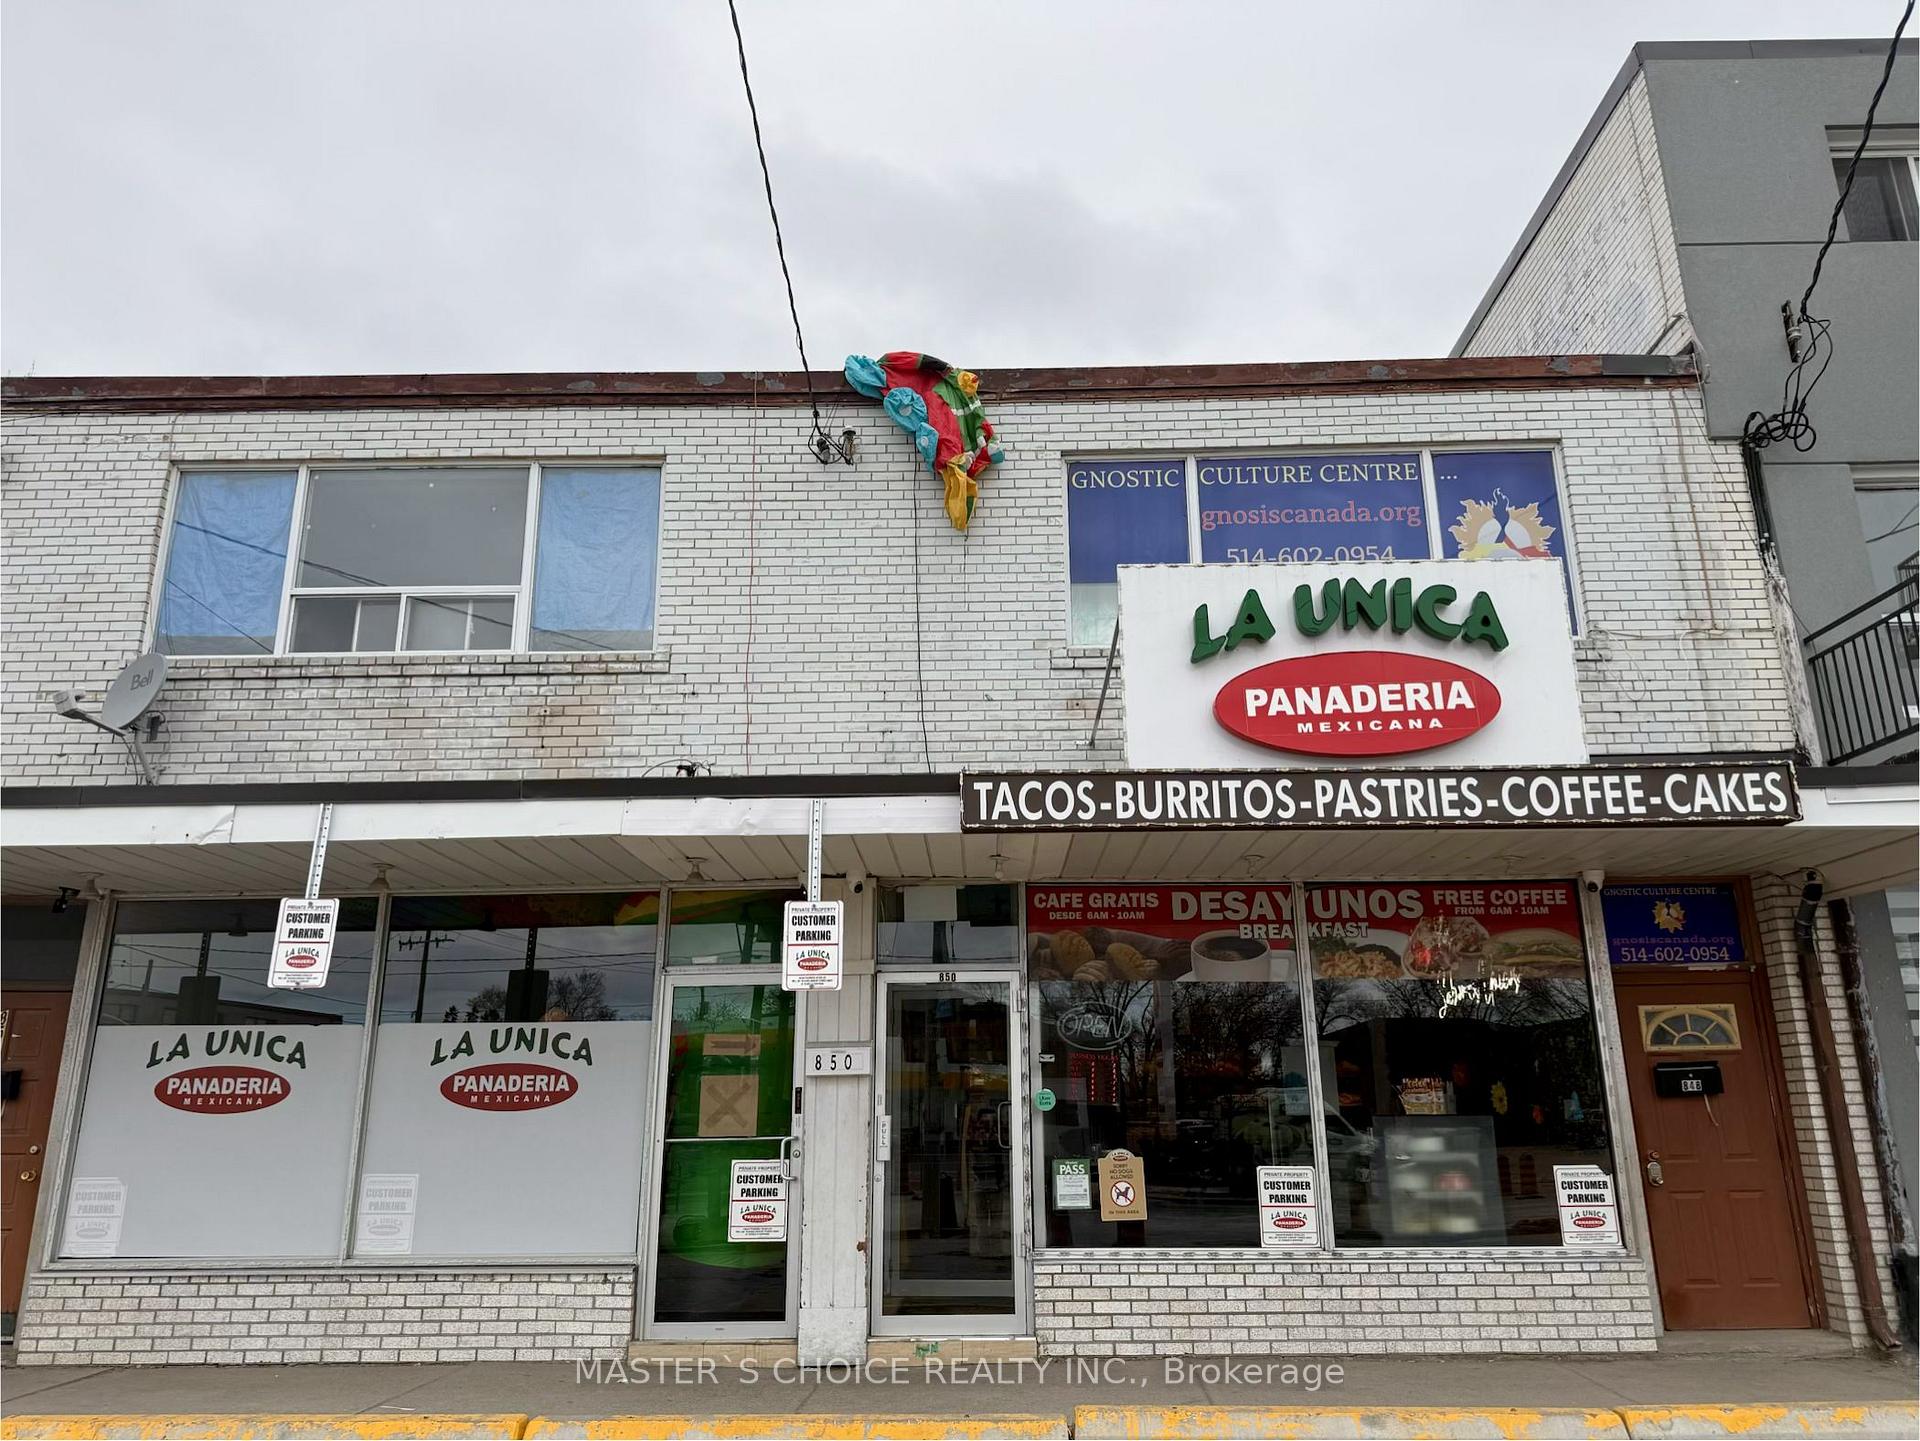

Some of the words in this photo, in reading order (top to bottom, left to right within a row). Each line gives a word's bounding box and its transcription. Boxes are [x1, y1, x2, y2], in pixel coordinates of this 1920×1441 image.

[1071, 468, 1180, 490] GNOSTIC
[1200, 464, 1314, 486] CULTURE
[1319, 462, 1418, 484] CENTRE
[1201, 500, 1421, 531] gnosiscanada.org
[1227, 546, 1396, 564] 514-602-0954
[1190, 588, 1276, 664] LA
[1292, 577, 1509, 652] UNICA
[130, 669, 154, 691] Bell
[1244, 680, 1476, 717] PANADERIA
[1297, 717, 1443, 734] MEXICANA
[1603, 887, 1641, 896] GNOSTIC
[1642, 887, 1681, 896] CULTURE
[1683, 886, 1718, 895] CENTRE
[1033, 892, 1084, 909] CAFE
[1088, 892, 1160, 909] GRATIS
[1432, 889, 1486, 905] FREE
[1489, 889, 1568, 905] COFFEE
[1171, 889, 1425, 921] DESAYUNOS
[1049, 911, 1082, 920] DESDE
[1087, 911, 1109, 920] 6AM
[1117, 911, 1145, 920] 10AM
[1454, 906, 1485, 915] FROM
[1490, 906, 1513, 915] 6AM
[1521, 906, 1549, 915] 10AM
[286, 913, 330, 923] CUSTOMER
[792, 915, 835, 926] CUSTOMER
[288, 928, 324, 938] PARKING
[796, 930, 831, 941] PARKING
[1239, 922, 1369, 940] BREAKFAST
[1612, 935, 1735, 945] gnosiscanada.org
[285, 948, 295, 957] LA
[298, 947, 319, 958] UNICA
[796, 950, 805, 960] LA
[808, 950, 830, 960] UNICA
[1621, 947, 1730, 962] 514-602-0954
[939, 972, 956, 982] 850
[1061, 1013, 1125, 1039] OPEN
[146, 1033, 190, 1069] LA
[205, 1030, 307, 1069] UNICA
[430, 1030, 474, 1066] LA
[490, 1027, 593, 1066] UNICA
[815, 1054, 852, 1071] 850
[166, 1078, 282, 1095] PANADERIA
[452, 1074, 570, 1092] PANADERIA
[470, 1095, 550, 1103] MEXICANA
[1060, 1164, 1086, 1175] PASS
[737, 1175, 783, 1184] CUSTOMER
[1264, 1181, 1311, 1190] CUSTOMER
[1561, 1181, 1608, 1190] CUSTOMER
[75, 1192, 121, 1200] CUSTOMER
[366, 1189, 412, 1198] CUSTOMER
[741, 1188, 778, 1197] PARKING
[1269, 1194, 1307, 1203] PARKING
[1567, 1194, 1605, 1203] PARKING
[77, 1205, 114, 1214] PARKING
[369, 1201, 406, 1211] PARKING
[740, 1206, 750, 1214] LA
[753, 1204, 776, 1213] UNICA
[1283, 1211, 1307, 1220] UNICA
[1571, 1211, 1580, 1219] LA
[1583, 1210, 1607, 1219] UNICA
